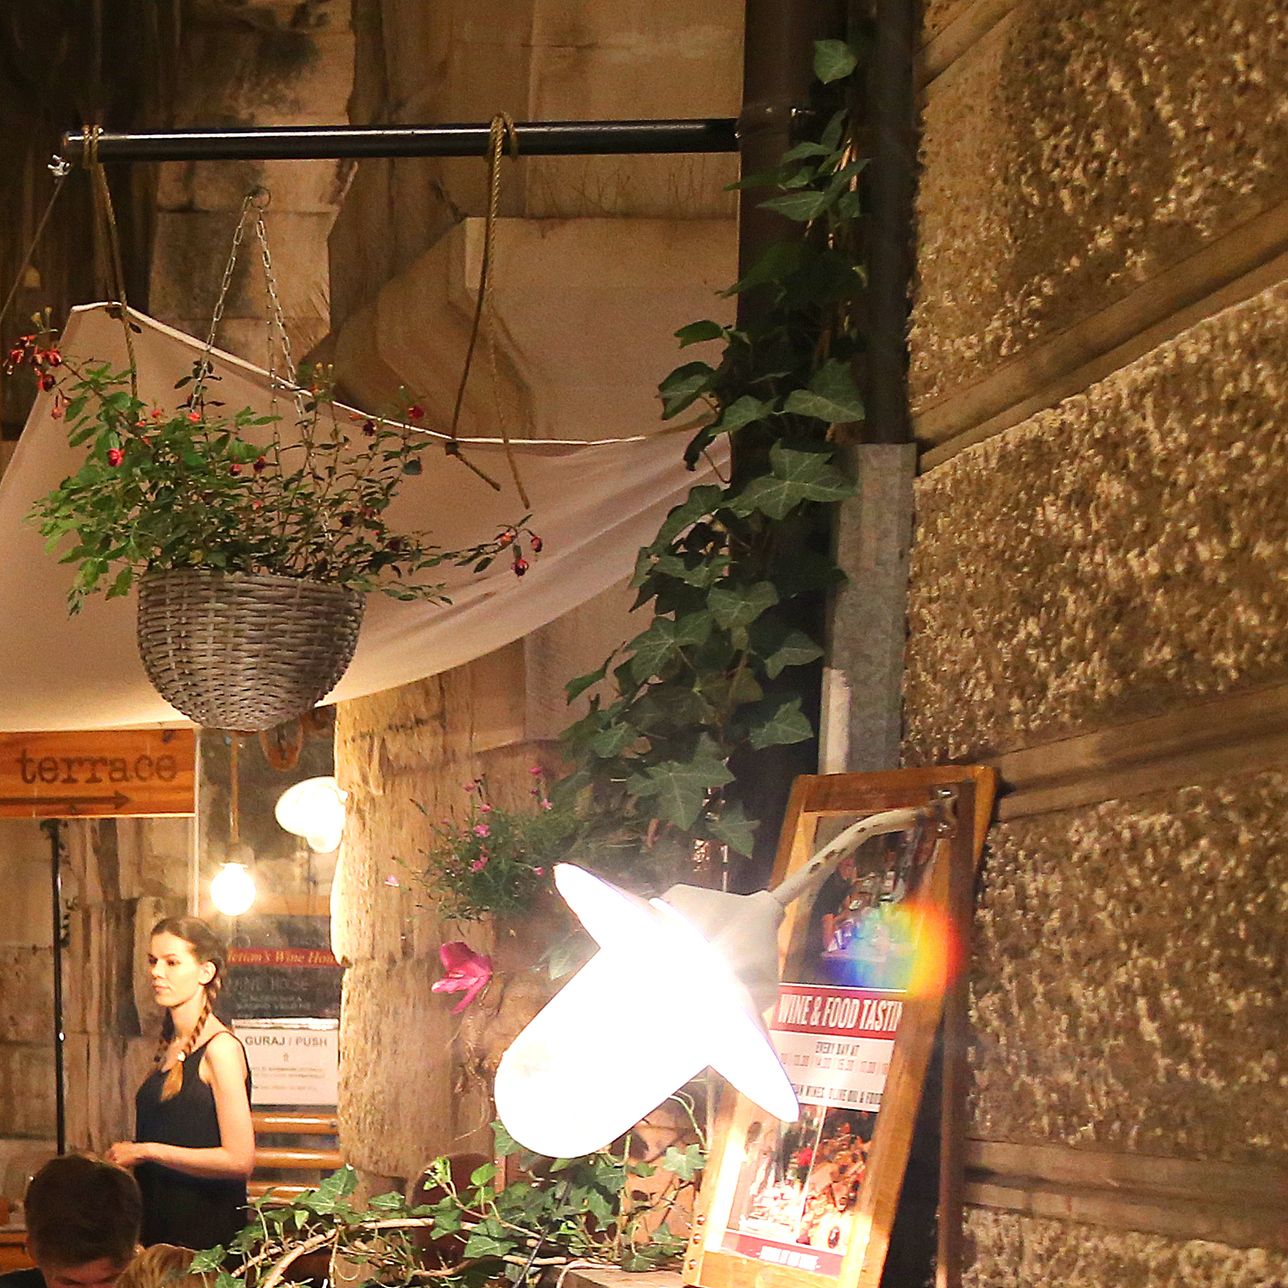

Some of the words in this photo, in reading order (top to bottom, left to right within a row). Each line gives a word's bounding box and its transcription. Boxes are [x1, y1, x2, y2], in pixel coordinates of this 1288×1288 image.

[16, 749, 179, 785] terrace
[778, 993, 813, 1025] WINE
[810, 996, 823, 1026] &
[822, 996, 860, 1029] FOOD
[245, 1035, 286, 1047] GURAJ
[296, 1036, 328, 1048] PUSH
